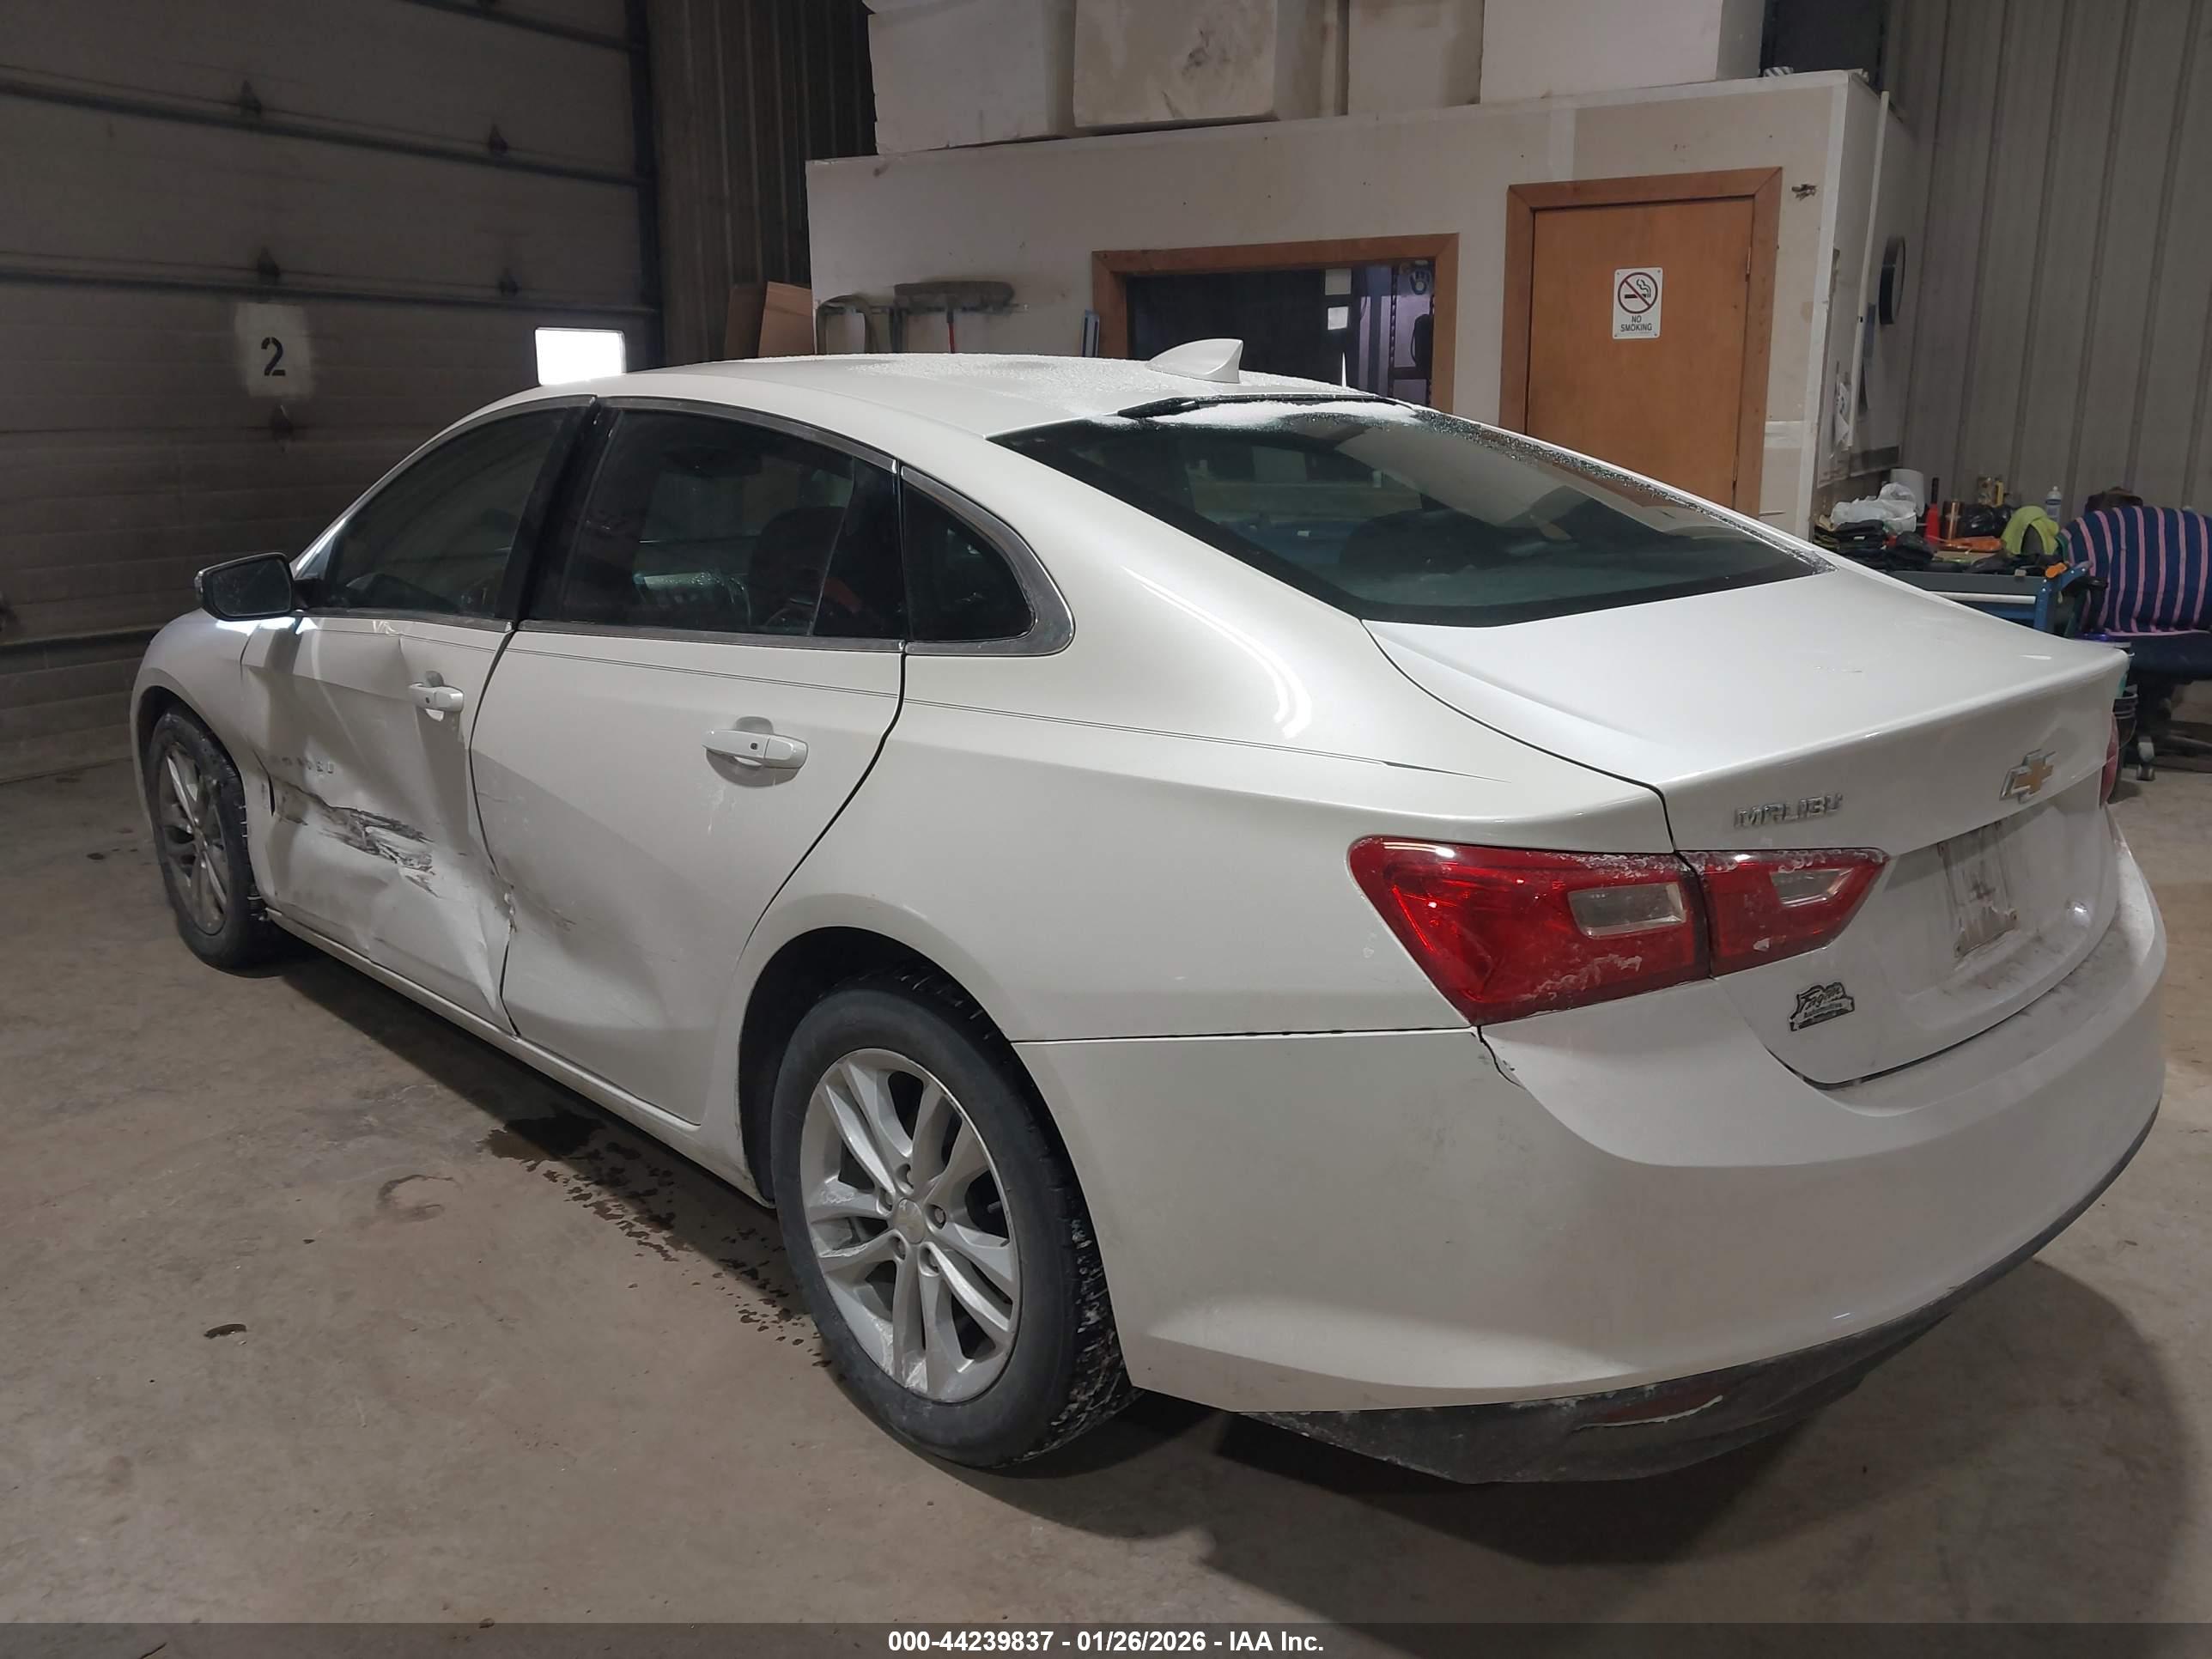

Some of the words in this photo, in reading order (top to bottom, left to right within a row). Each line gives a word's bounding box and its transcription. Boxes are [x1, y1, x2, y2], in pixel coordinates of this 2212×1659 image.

[1620, 324, 1652, 332] SMOKING
[1632, 315, 1642, 324] NO
[260, 336, 286, 377] 2
[1734, 793, 1843, 828] MALIBU
